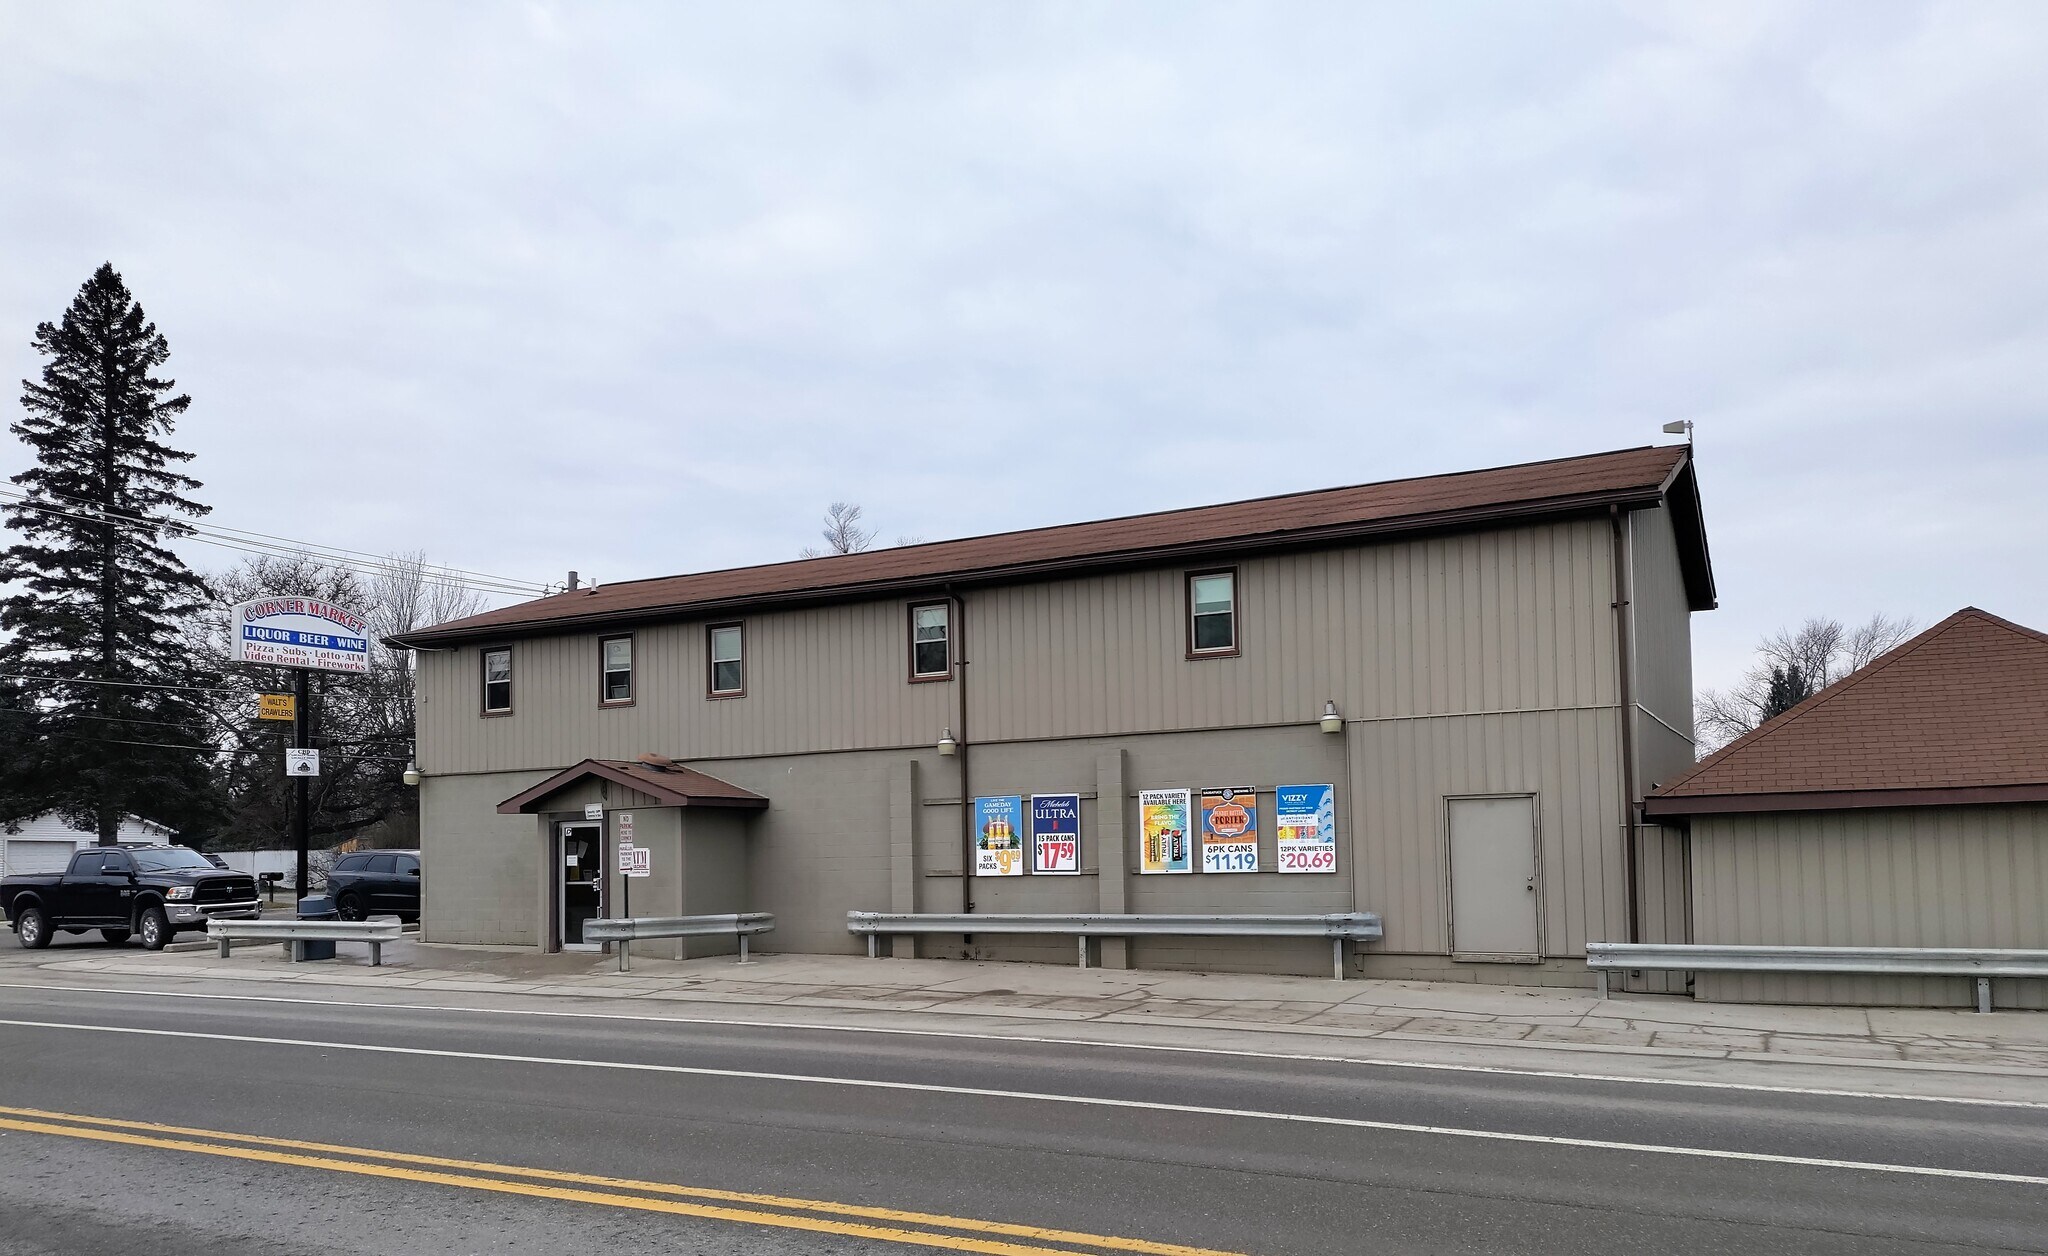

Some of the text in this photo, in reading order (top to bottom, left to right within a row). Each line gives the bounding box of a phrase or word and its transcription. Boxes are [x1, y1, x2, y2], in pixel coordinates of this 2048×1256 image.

[244, 600, 367, 636] CORNER MARKET
[244, 626, 365, 650] LIQUOR BEER WINE
[246, 642, 364, 663] Pizza Subs Lotto ATM
[244, 651, 366, 671] Video Rental Fireworks
[267, 698, 287, 706] WALT'S
[261, 707, 293, 717] CRAWLERS
[1281, 794, 1308, 802] VIZZY
[1034, 808, 1077, 819] ULTRA
[1214, 815, 1245, 825] PORTER
[1060, 834, 1075, 842] CANS
[1227, 845, 1253, 853] CANS
[1205, 853, 1256, 870] $11.19
[1280, 852, 1333, 868] $20.69
